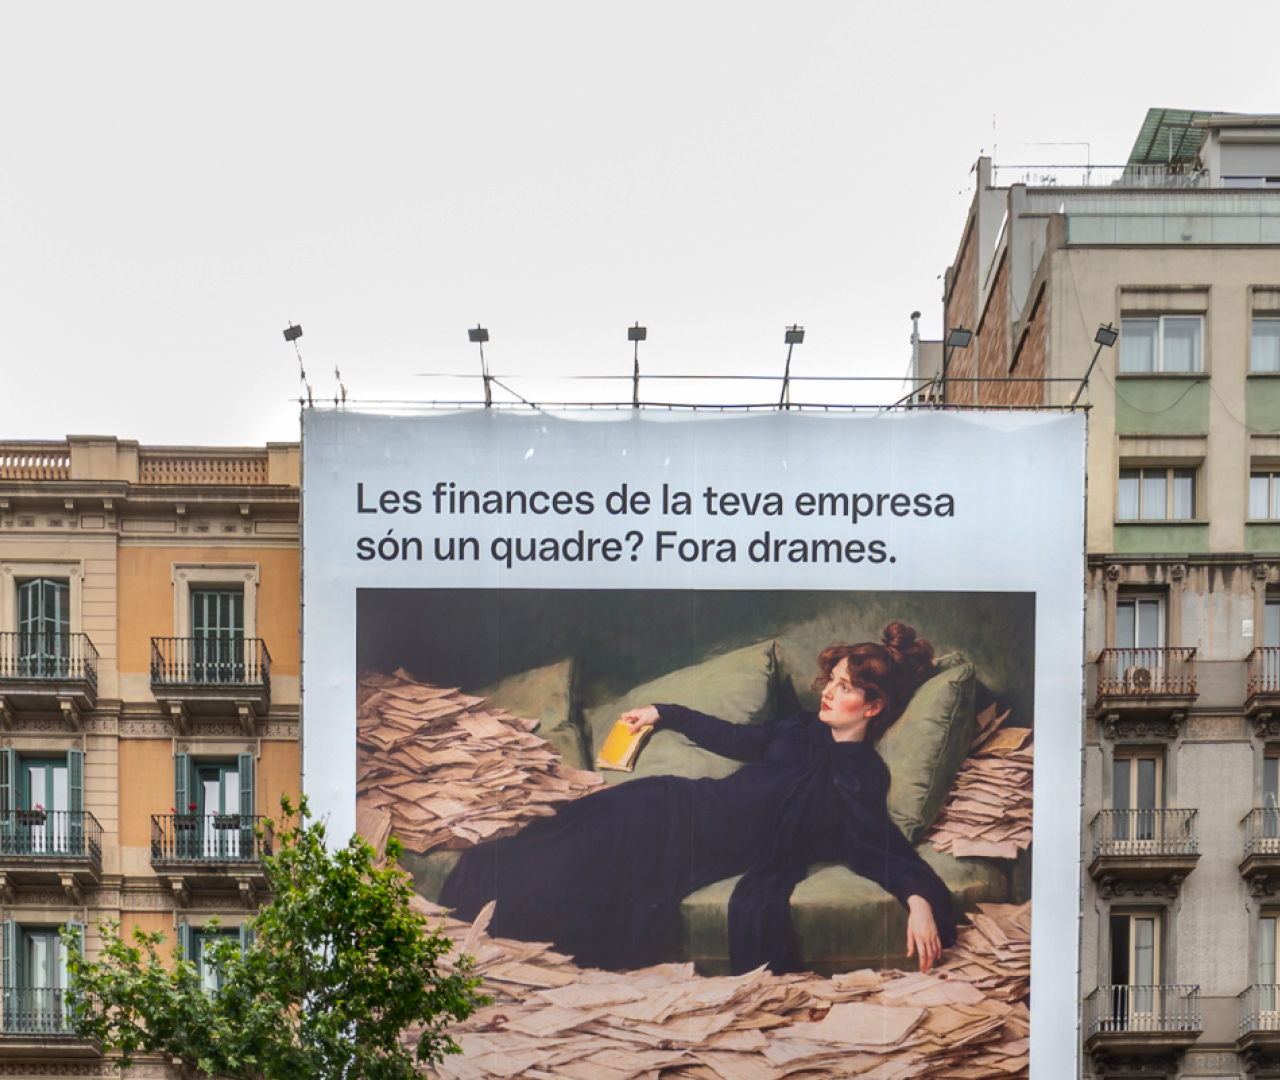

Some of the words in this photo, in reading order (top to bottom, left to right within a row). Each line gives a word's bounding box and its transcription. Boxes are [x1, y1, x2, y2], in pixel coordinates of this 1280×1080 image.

[356, 483, 422, 516] Les
[432, 482, 595, 517] finances
[605, 484, 652, 516] de
[662, 484, 692, 516] la
[702, 487, 785, 517] teva
[794, 491, 955, 523] empresa
[356, 530, 423, 562] són
[433, 537, 481, 562] un
[490, 530, 644, 568] quadre?
[655, 531, 737, 564] Fora
[748, 532, 897, 565] drames.
